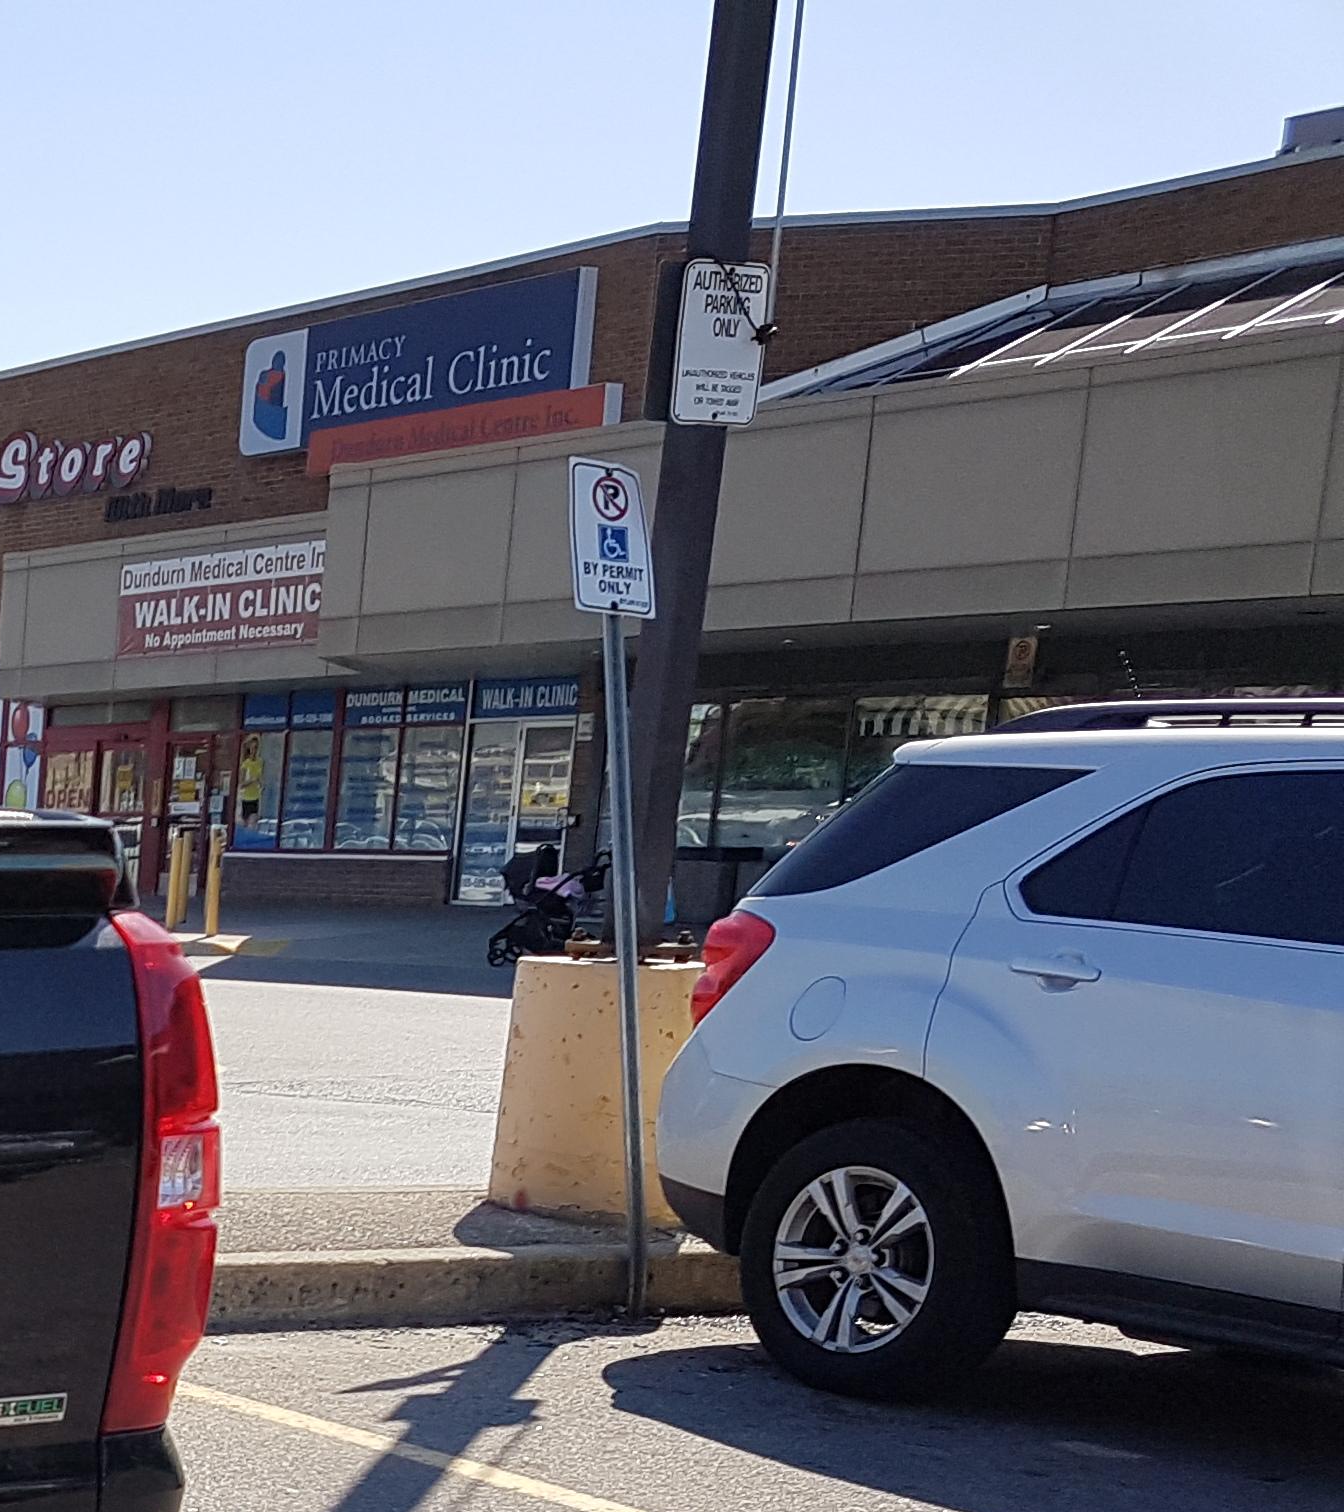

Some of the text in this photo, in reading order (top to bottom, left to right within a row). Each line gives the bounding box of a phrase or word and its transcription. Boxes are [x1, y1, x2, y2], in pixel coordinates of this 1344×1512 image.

[693, 270, 762, 294] AUTHORIZED
[704, 294, 751, 315] PARKING
[712, 317, 741, 338] ONLY
[314, 335, 406, 373] PRIMACY
[309, 338, 551, 420] Medical Clinic
[123, 567, 185, 591] Dundurn
[190, 556, 248, 583] Medical
[253, 553, 306, 576] Centre
[583, 561, 645, 582] BY PERMIT
[598, 579, 632, 595] ONLY
[135, 582, 322, 629] WALK-IN CLINIC
[144, 622, 304, 649] No Appointment Necessary
[345, 688, 465, 708] DUNDURN MEDICAL
[482, 684, 579, 710] WALK-IN CLINIC
[361, 711, 456, 725] BOOKED SERVICES
